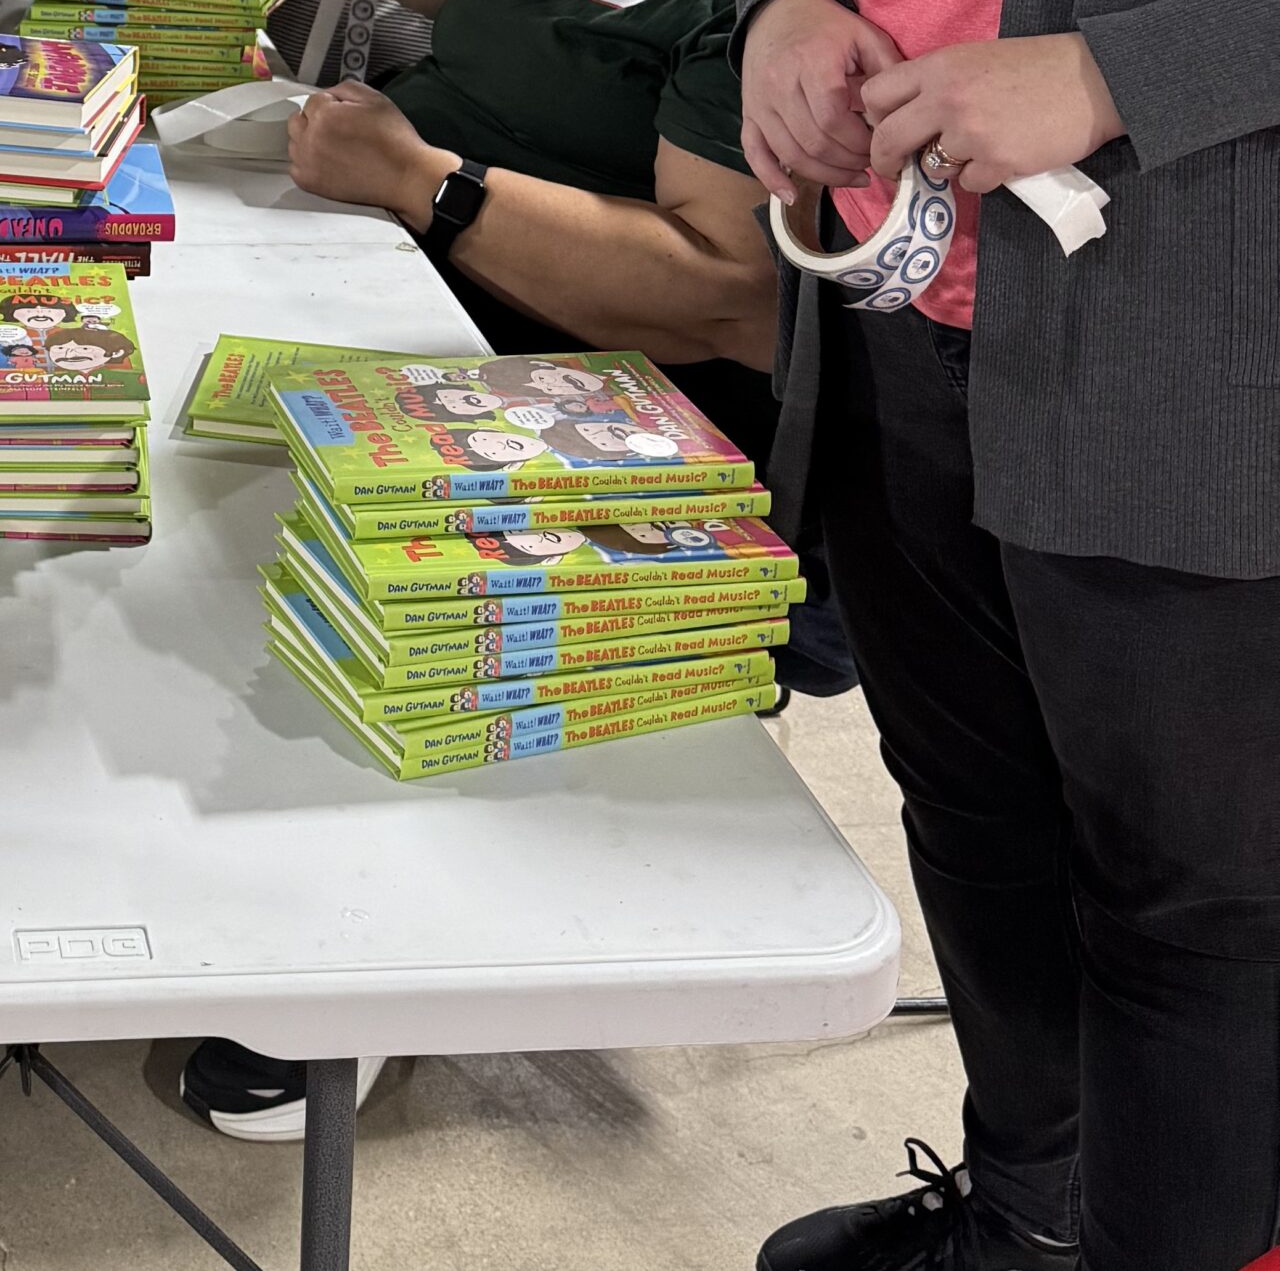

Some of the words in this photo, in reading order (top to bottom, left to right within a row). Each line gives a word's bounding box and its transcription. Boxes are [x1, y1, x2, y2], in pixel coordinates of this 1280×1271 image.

[105, 222, 161, 235] BROADDUS
[12, 294, 116, 305] Music?
[5, 373, 103, 383] GUTMAN
[375, 366, 435, 418] Music?
[602, 369, 665, 414] GUTMAN
[313, 369, 385, 433] BEATLES
[651, 416, 688, 441] DAN
[367, 432, 409, 467] The
[415, 423, 473, 466] Read
[354, 486, 374, 495] DAN
[376, 484, 416, 494] GUTMAN
[454, 482, 477, 491] Wait!
[479, 480, 504, 491] WHAT?
[511, 479, 536, 491] The
[538, 477, 589, 489] BEATLES
[592, 475, 627, 486] Couldn't
[631, 474, 661, 485] Read
[665, 472, 707, 484] Music?
[377, 522, 397, 530] DAN
[399, 520, 439, 530] GUTMAN
[477, 515, 499, 525] Wait!
[501, 513, 526, 524] WHAT?
[533, 512, 558, 524] The
[559, 510, 610, 523] BEATLES
[613, 508, 648, 519] Couldn't
[651, 504, 682, 516] Read
[685, 503, 727, 515] Music?
[402, 536, 443, 562] Th
[388, 583, 408, 592] DAN
[410, 582, 452, 592] GUTMAN
[490, 579, 514, 588] Wait!
[515, 576, 542, 588] WHAT?
[549, 575, 575, 587] The
[576, 572, 629, 586] BEATLES
[632, 570, 668, 581] Couldn't
[671, 569, 704, 581] Read
[706, 567, 750, 579] Music?
[405, 614, 425, 623] DAN
[427, 611, 468, 622] GUTMAN
[506, 607, 530, 616] Wait!
[531, 603, 557, 615] WHAT?
[564, 602, 589, 613] The
[591, 598, 642, 612] BEATLES
[644, 596, 680, 607] Couldn't
[683, 593, 715, 605] Read
[718, 590, 761, 602] Music?
[384, 704, 403, 715] DAN
[405, 700, 444, 712] GUTMAN
[481, 692, 504, 702] Wait!
[506, 688, 531, 700] WHAT?
[538, 684, 561, 697] The
[563, 678, 613, 694] BEATLES
[615, 674, 649, 686] Couldn't
[652, 670, 682, 682] Read
[685, 664, 724, 678] Music?
[422, 759, 440, 769] DAN
[442, 751, 479, 764] GUTMAN
[514, 740, 535, 751] Wait!
[536, 734, 559, 747] WHAT?
[565, 729, 588, 743] The
[589, 719, 635, 738] BEATLES
[636, 714, 668, 728] Couldn't
[670, 707, 698, 721] Read
[701, 699, 738, 715] Music?
